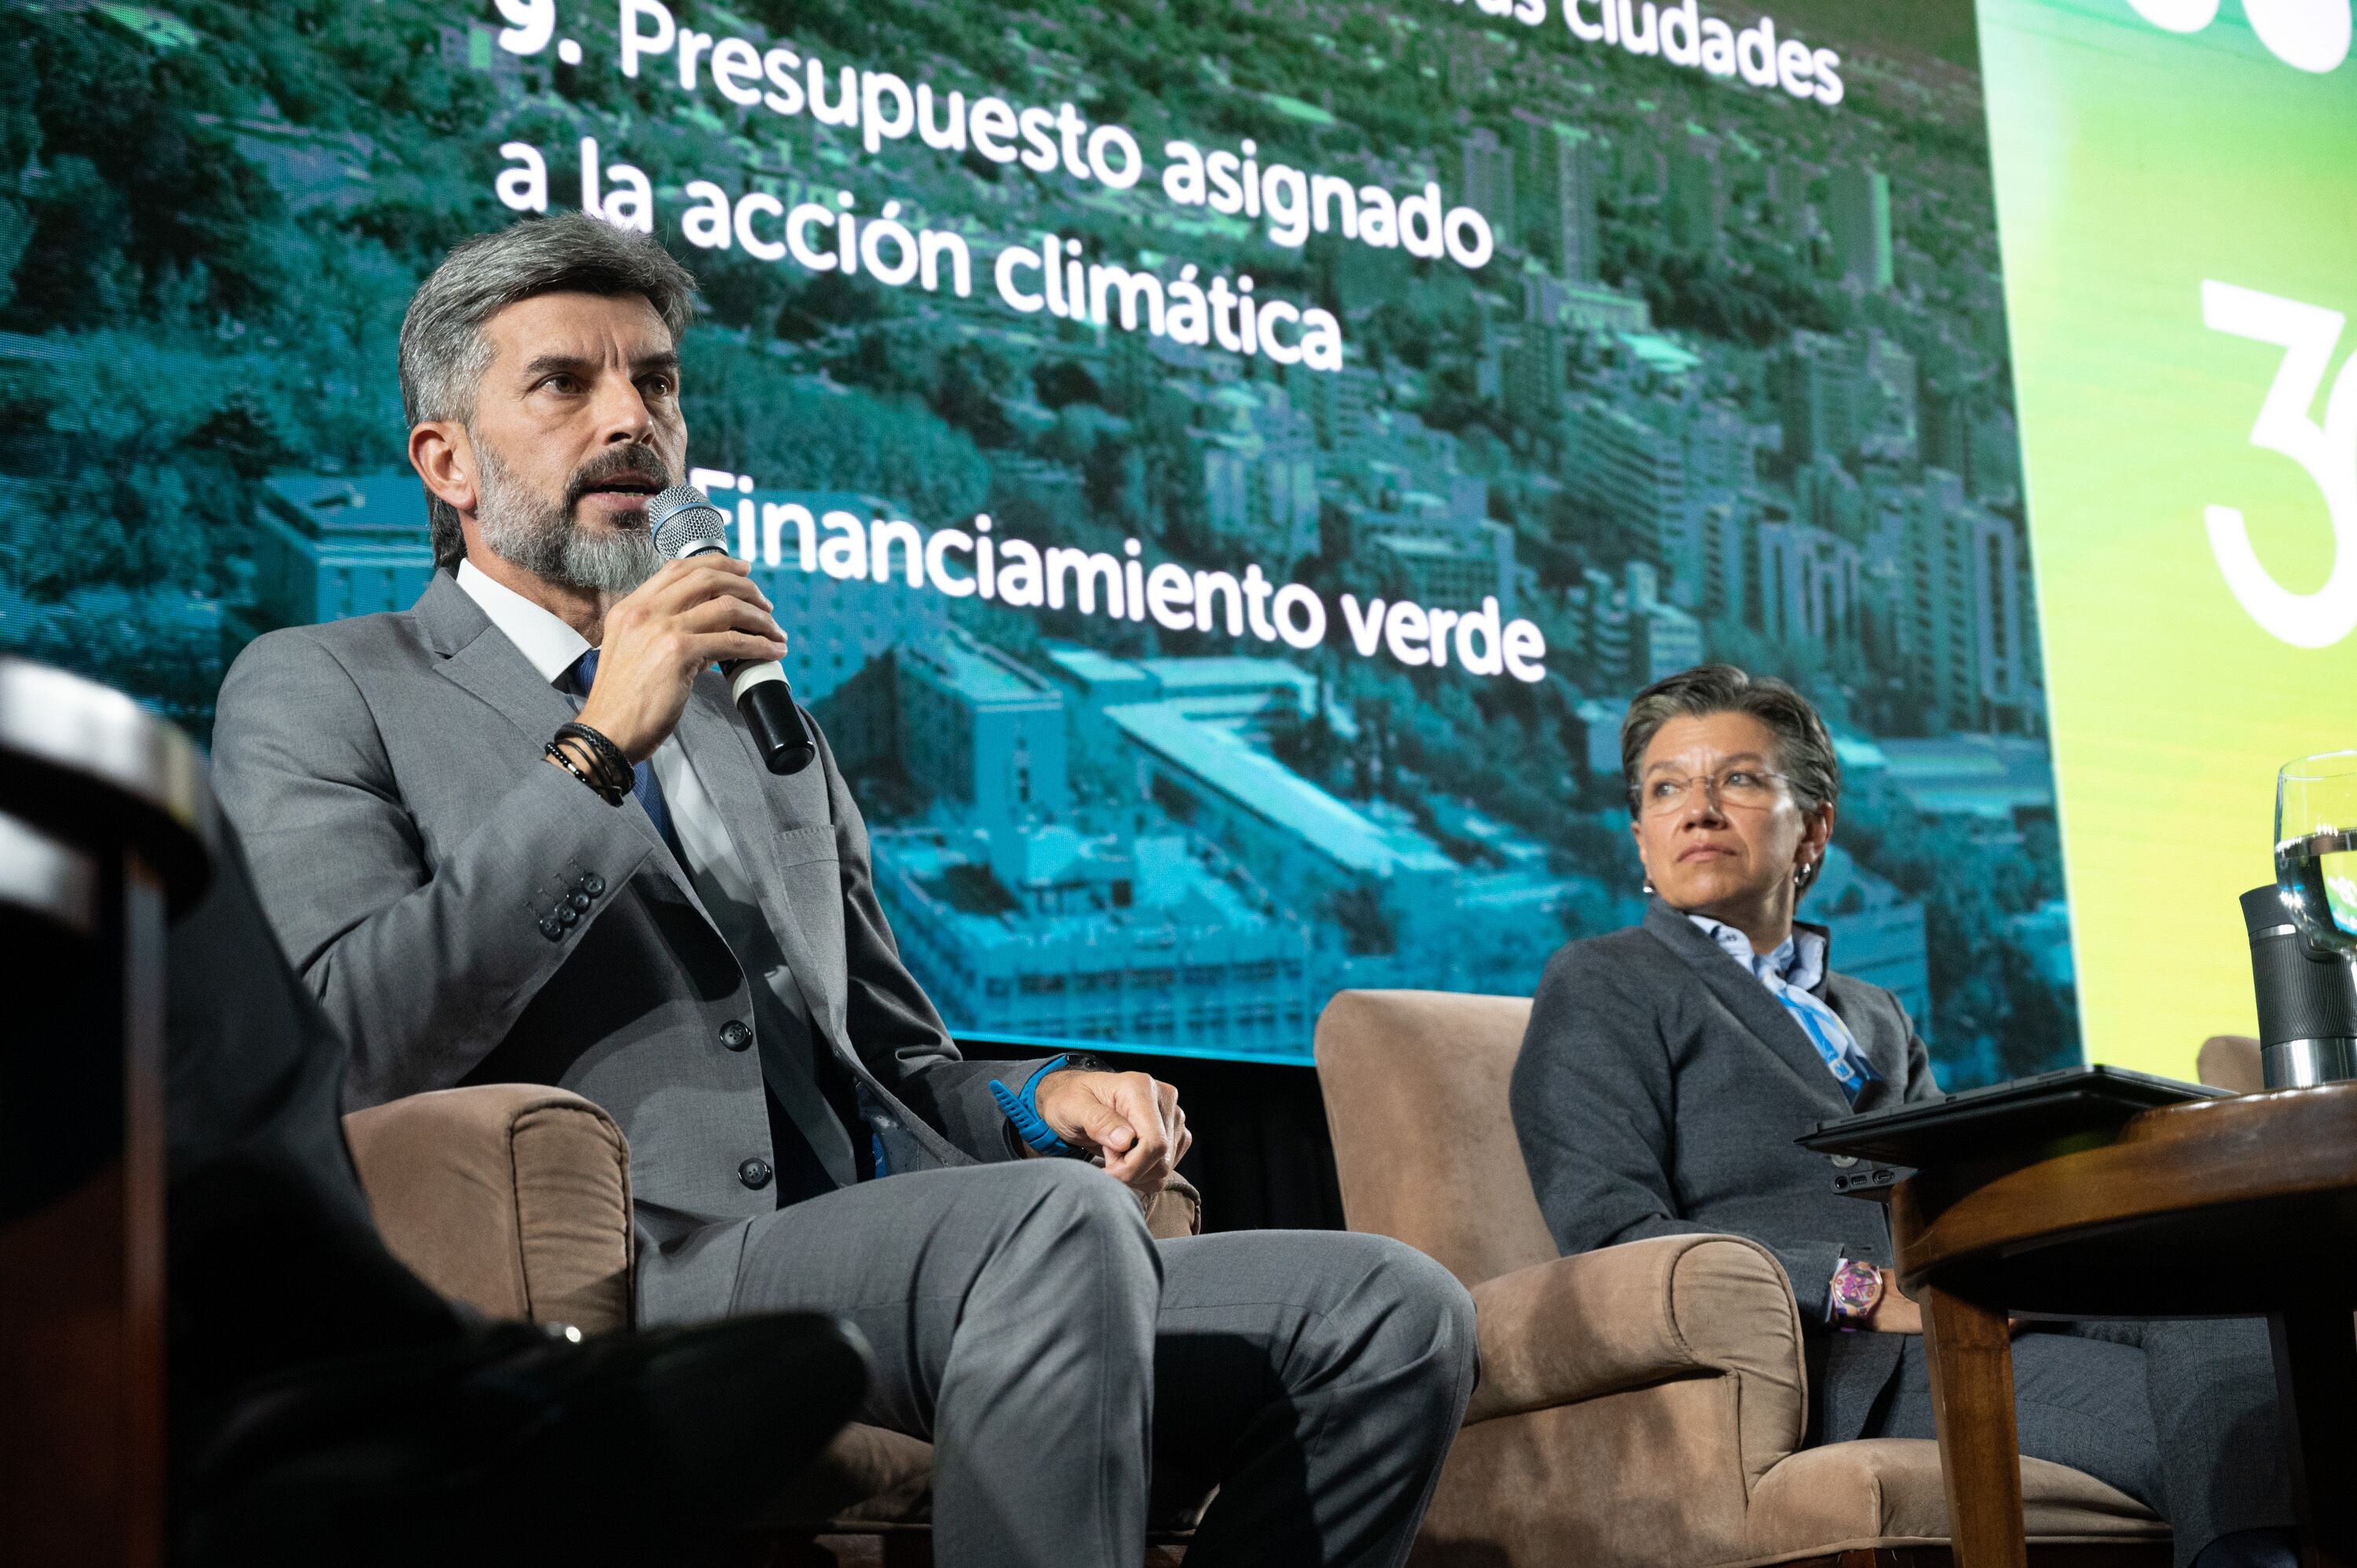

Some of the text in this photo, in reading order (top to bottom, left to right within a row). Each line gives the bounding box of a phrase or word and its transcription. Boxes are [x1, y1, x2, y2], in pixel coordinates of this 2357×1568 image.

[495, 136, 1343, 372] a la acción climática
[619, 0, 1143, 190] Presupuesto
[1162, 138, 1494, 269] asignado
[2199, 277, 2357, 650] 3
[1340, 593, 1546, 683] verde
